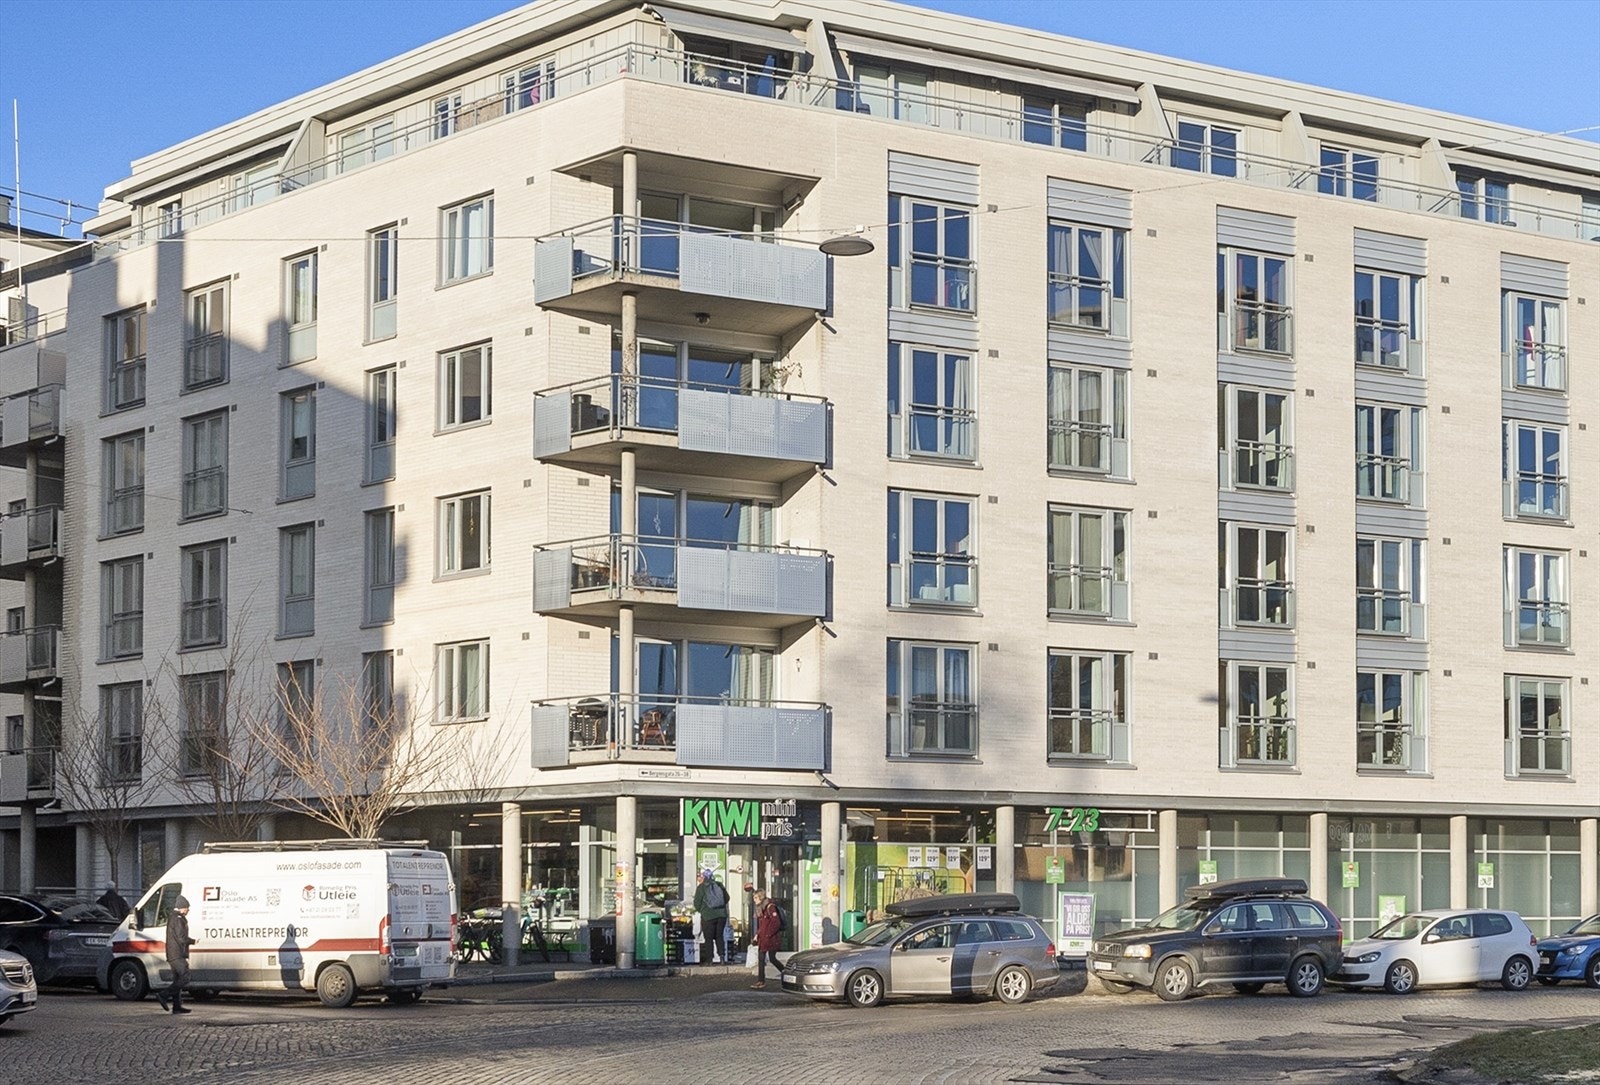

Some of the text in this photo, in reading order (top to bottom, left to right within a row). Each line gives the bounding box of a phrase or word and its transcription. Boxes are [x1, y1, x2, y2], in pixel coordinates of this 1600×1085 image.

[761, 799, 797, 817] mini
[681, 798, 760, 837] KIWI
[1044, 806, 1100, 833] 7-23
[761, 818, 793, 840] pris
[276, 861, 362, 871] www.oslofasade.com
[319, 890, 357, 900] Utleie
[204, 927, 309, 938] TOTALENTREPRENOR
